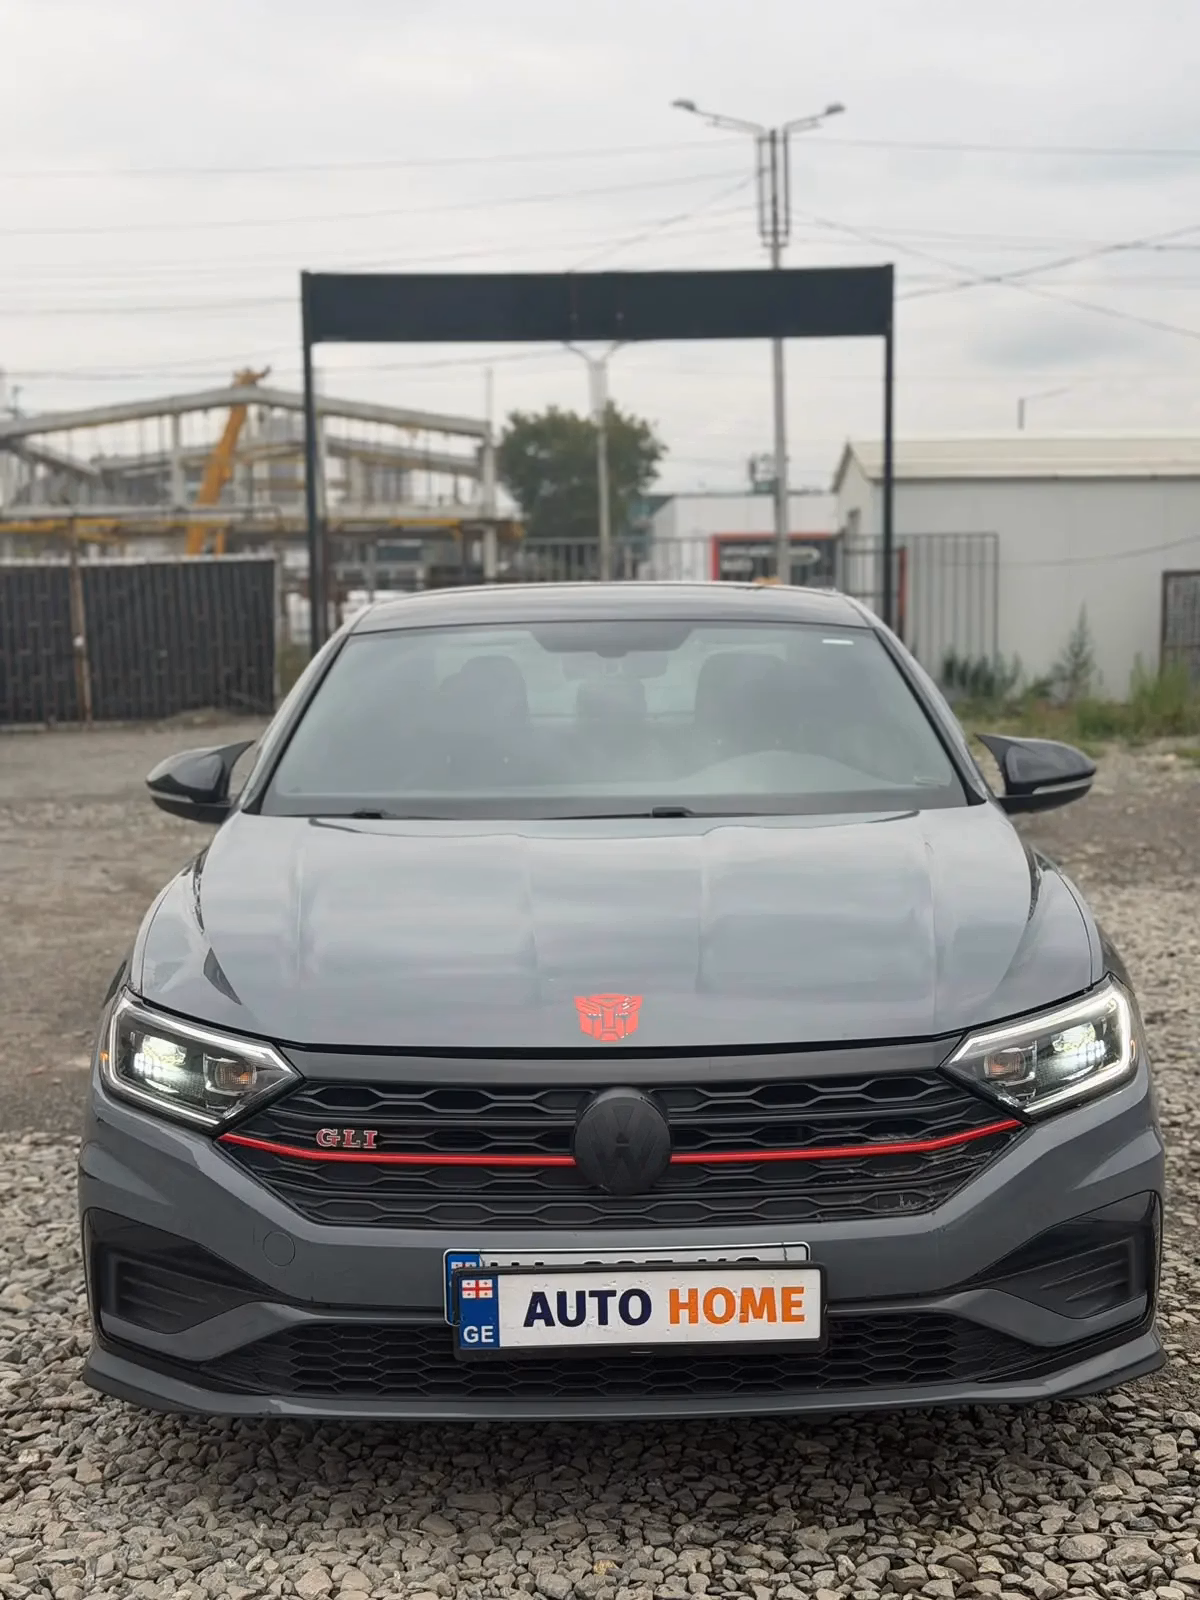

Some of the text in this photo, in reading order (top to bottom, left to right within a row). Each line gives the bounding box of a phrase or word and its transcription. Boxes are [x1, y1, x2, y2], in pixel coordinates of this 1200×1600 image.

[316, 1128, 378, 1149] GLI
[523, 1286, 805, 1328] AUTO HOME
[463, 1325, 494, 1343] GE
